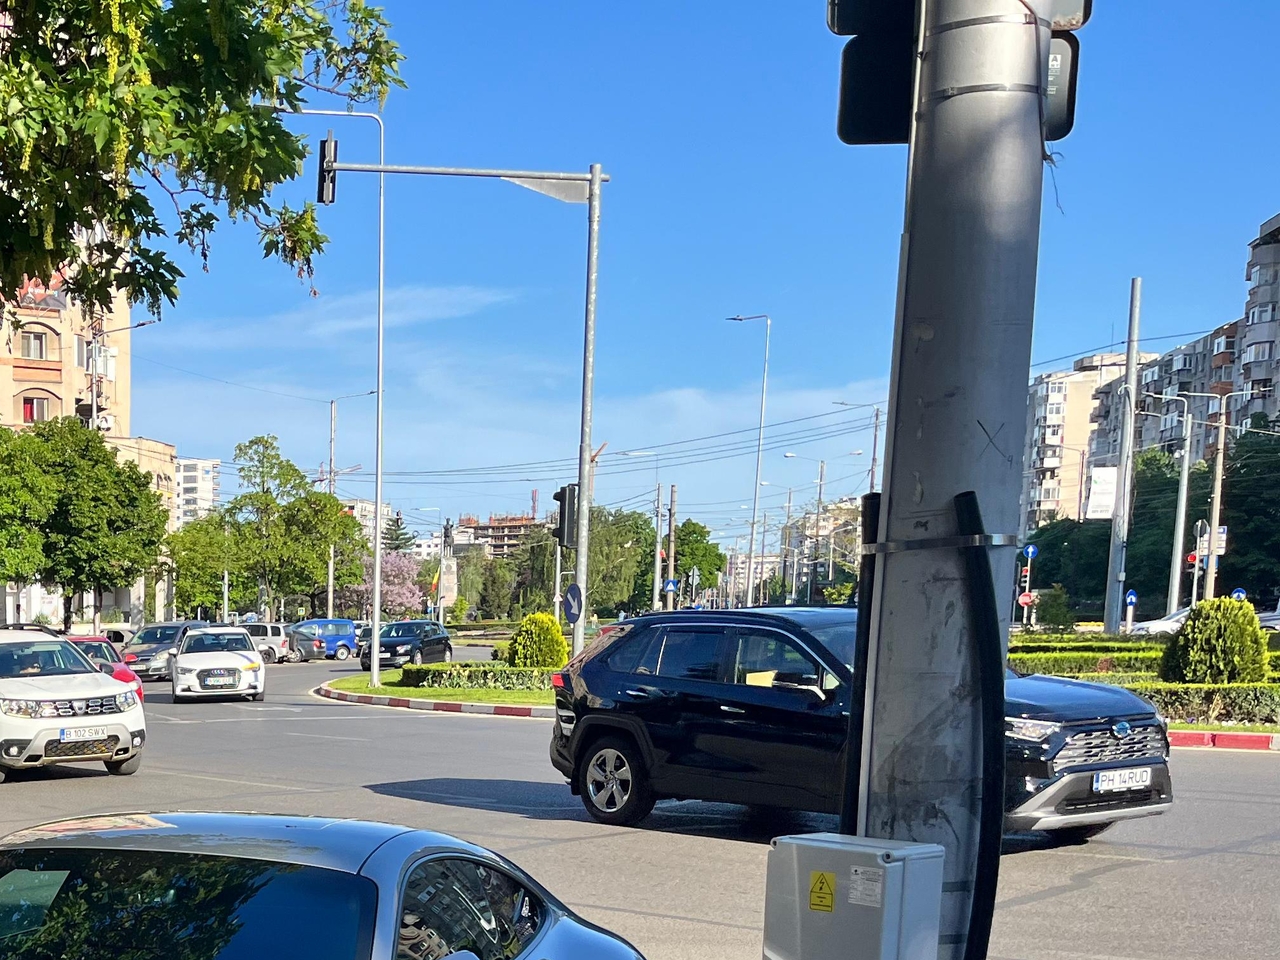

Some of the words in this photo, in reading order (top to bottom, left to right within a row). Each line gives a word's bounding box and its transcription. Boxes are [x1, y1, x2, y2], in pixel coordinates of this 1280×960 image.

[65, 730, 72, 739] B
[74, 729, 87, 738] 102
[88, 727, 106, 737] SWX
[1101, 774, 1115, 787] PH
